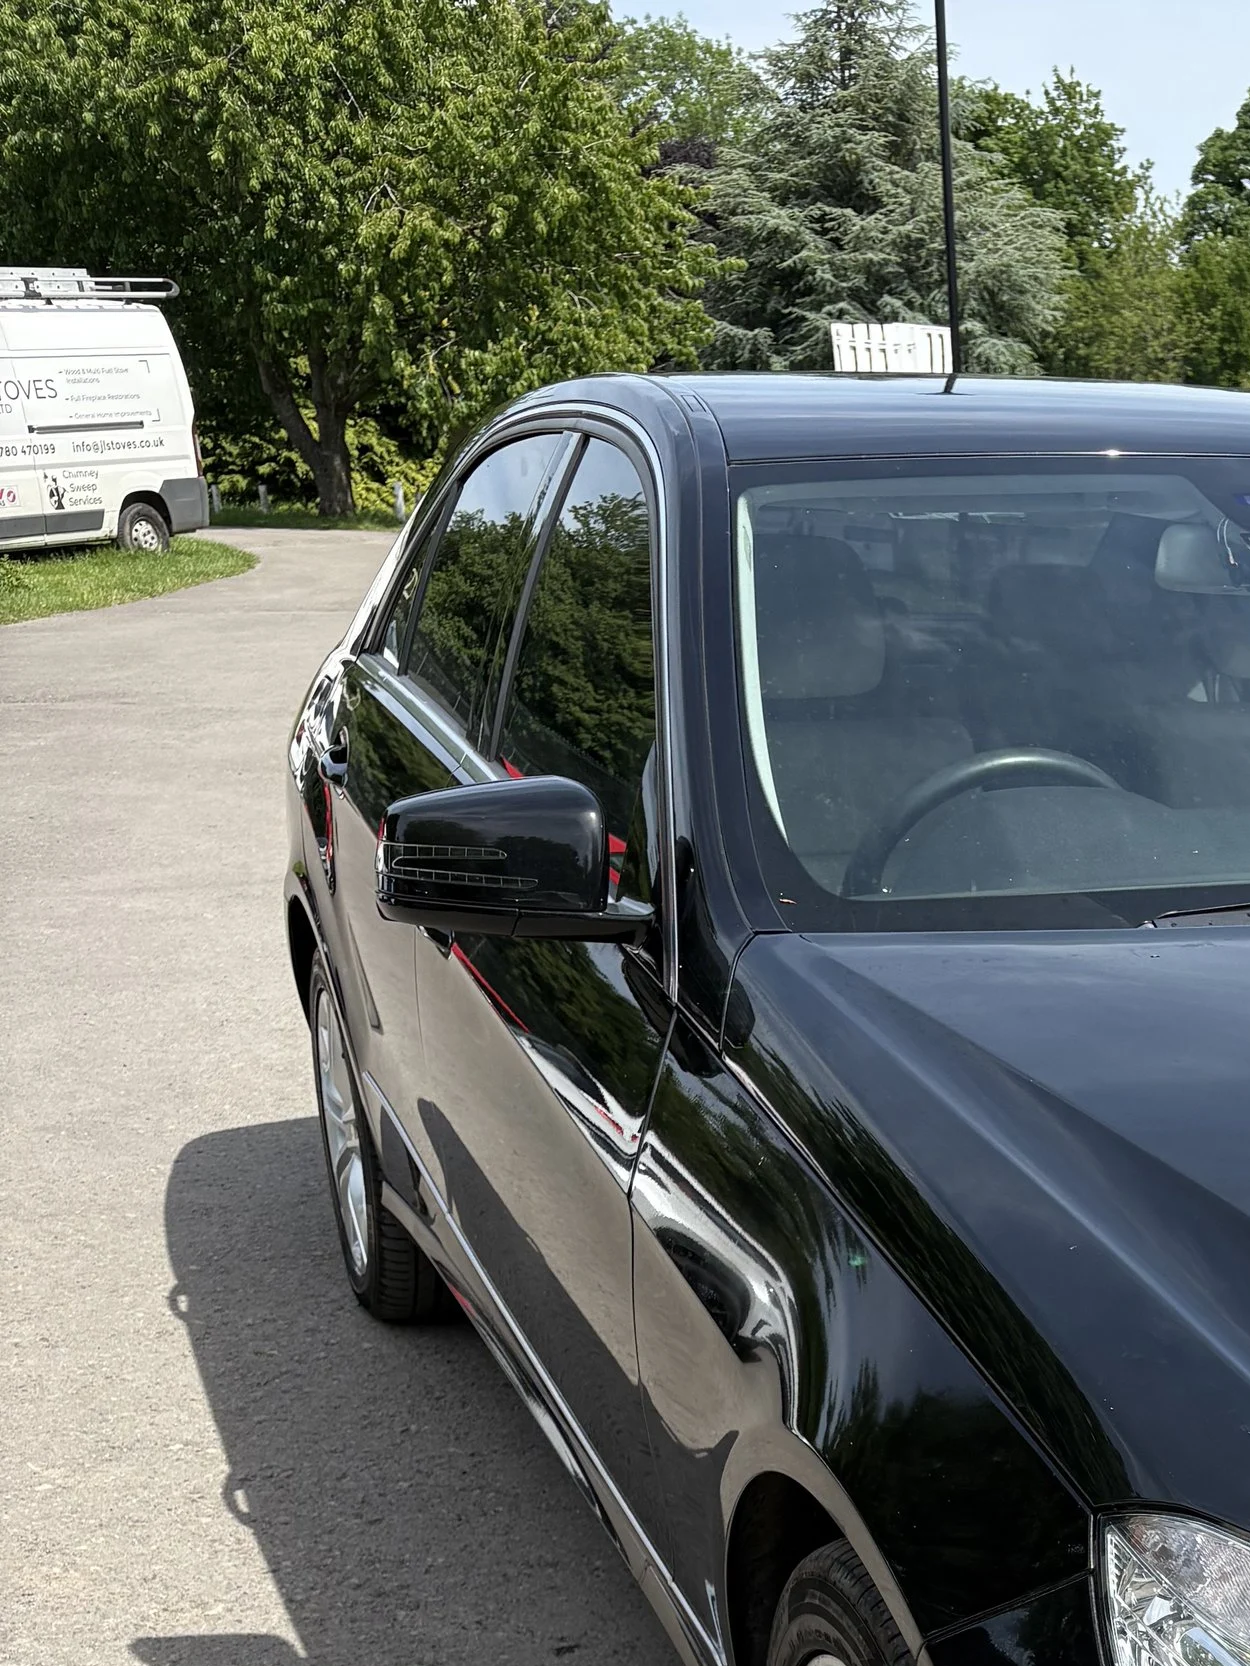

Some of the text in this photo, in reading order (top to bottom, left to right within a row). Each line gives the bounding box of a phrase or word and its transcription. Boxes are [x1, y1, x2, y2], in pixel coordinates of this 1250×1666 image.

[0, 378, 58, 401] OVES
[0, 404, 12, 415] TD
[21, 443, 56, 456] 470199
[72, 436, 165, 454] info@jlstoves.co.uk
[62, 470, 99, 480] Chimney
[69, 483, 98, 493] Sweep
[68, 496, 103, 507] Services
